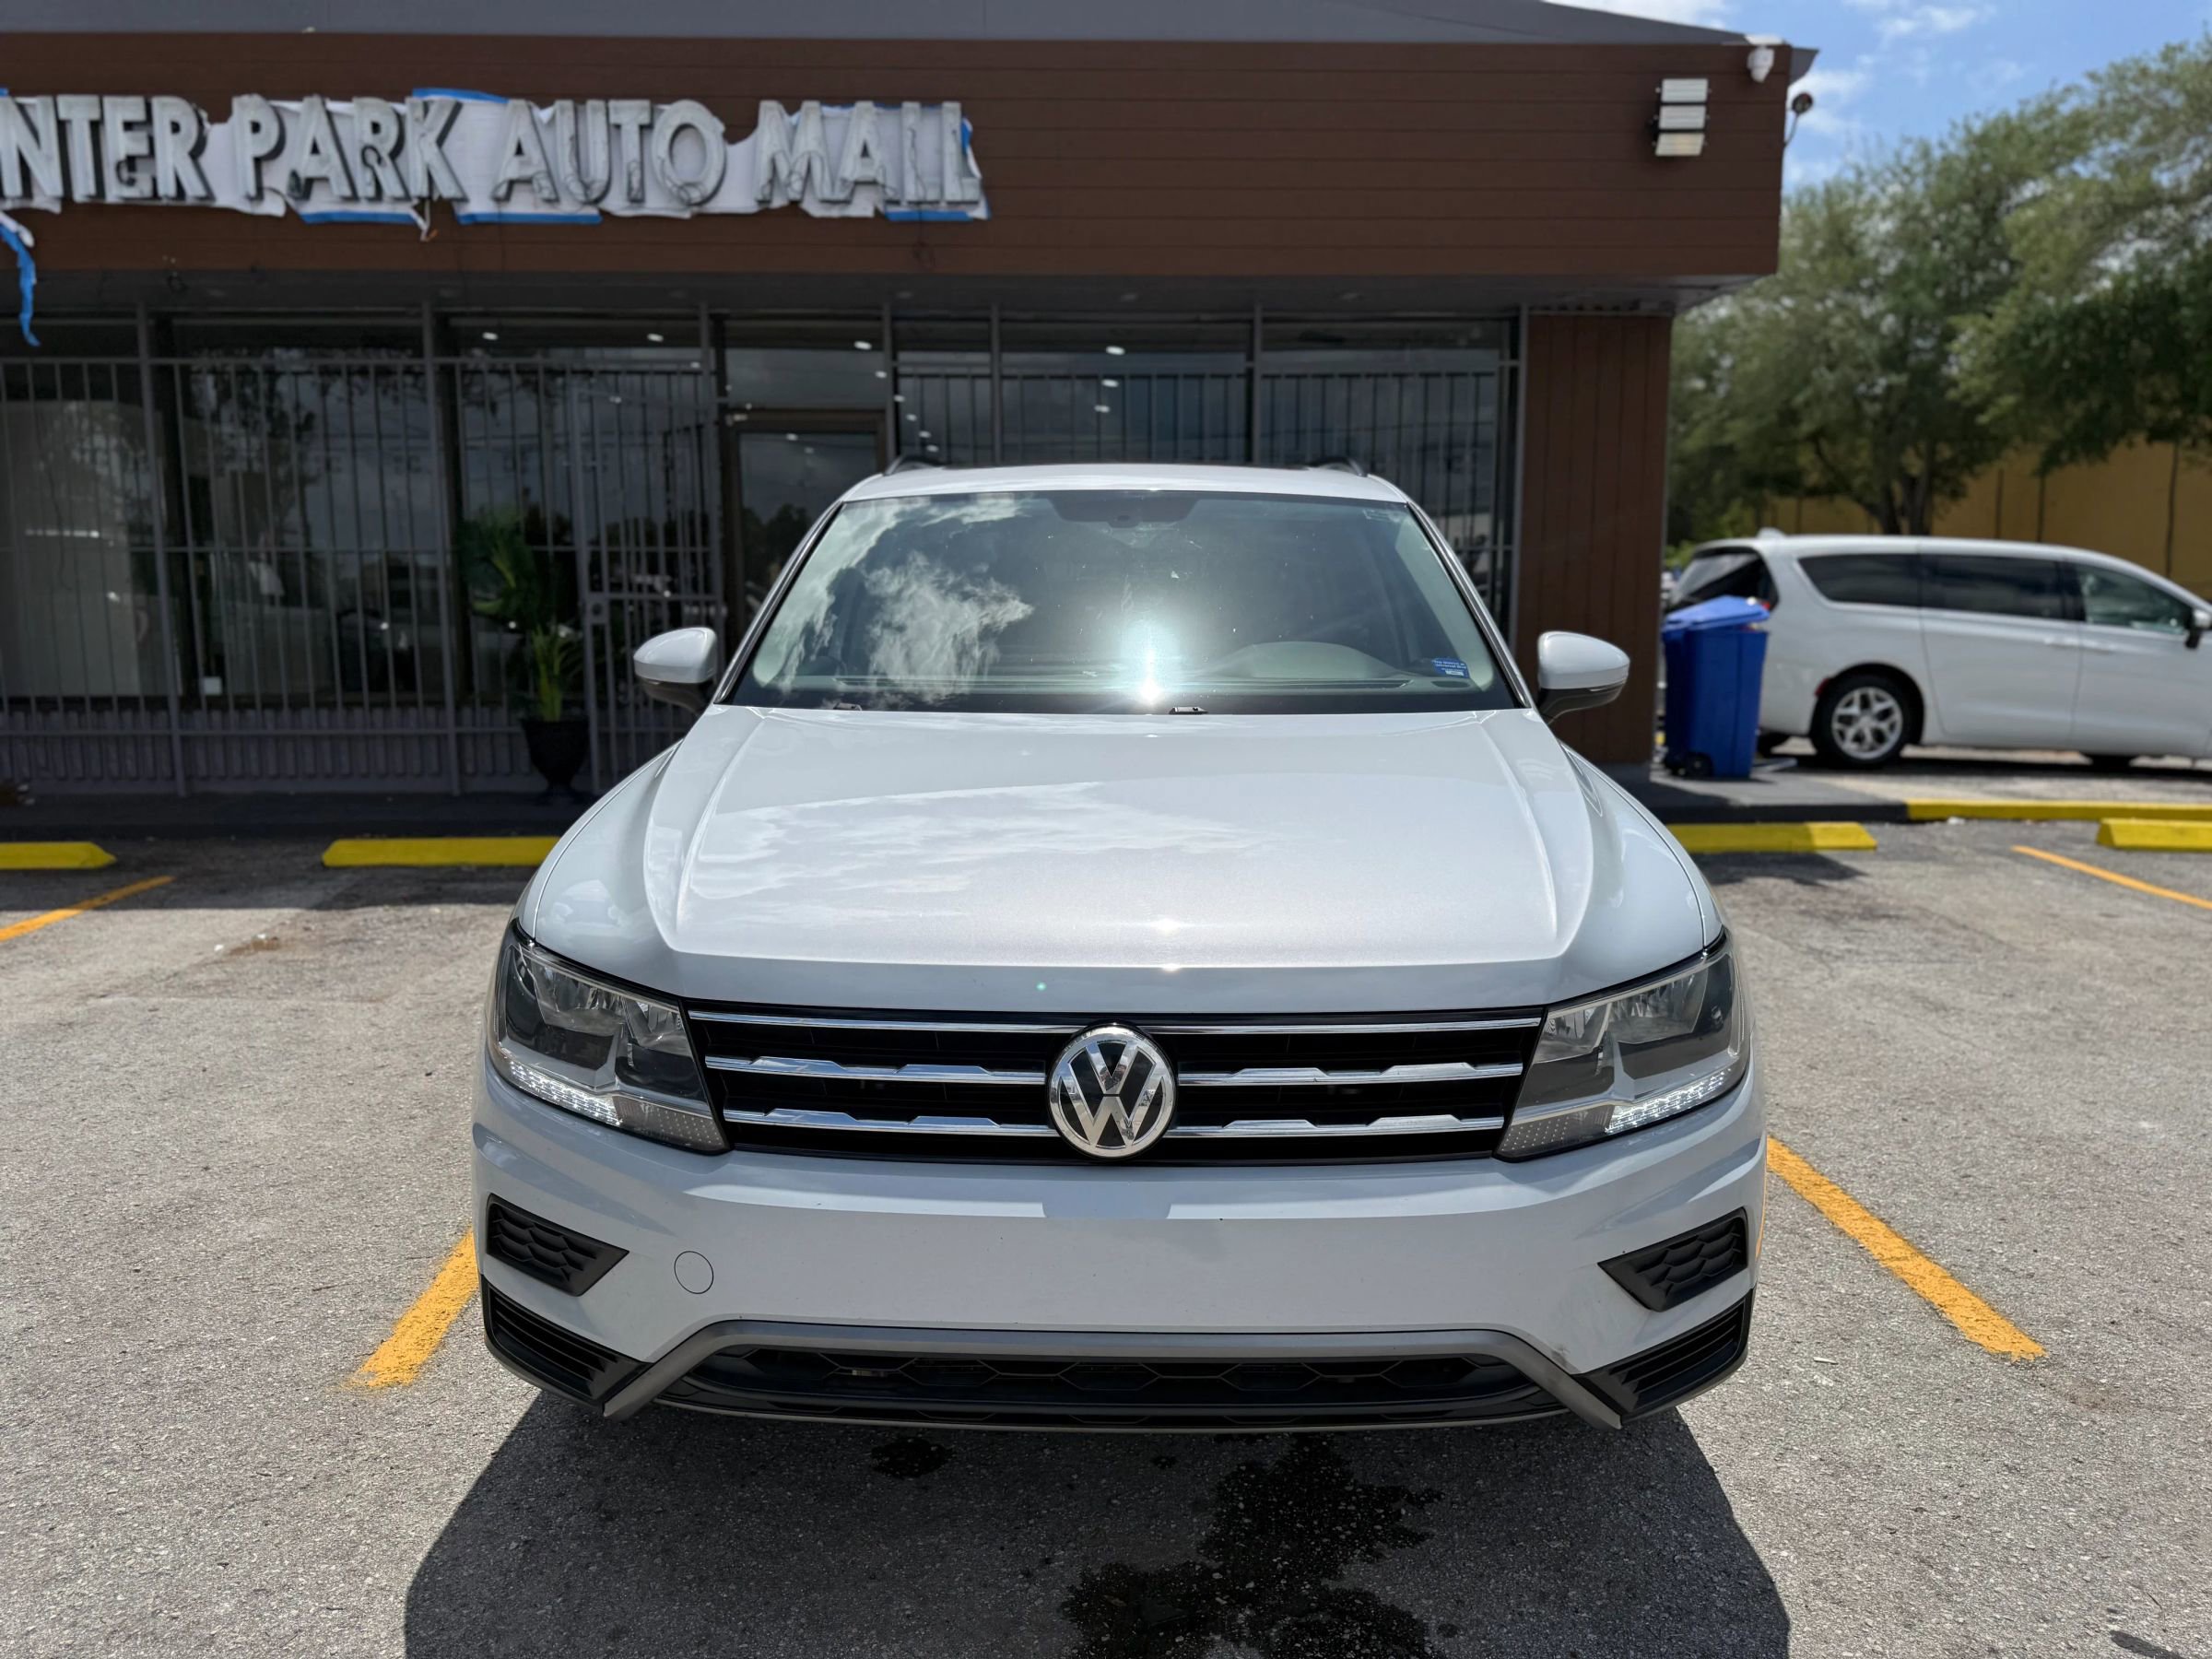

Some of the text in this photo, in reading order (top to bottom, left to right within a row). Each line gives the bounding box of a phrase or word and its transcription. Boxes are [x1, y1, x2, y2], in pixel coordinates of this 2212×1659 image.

[0, 94, 981, 205] NTER PARK AUTO MALL
[1054, 1031, 1169, 1152] VW
